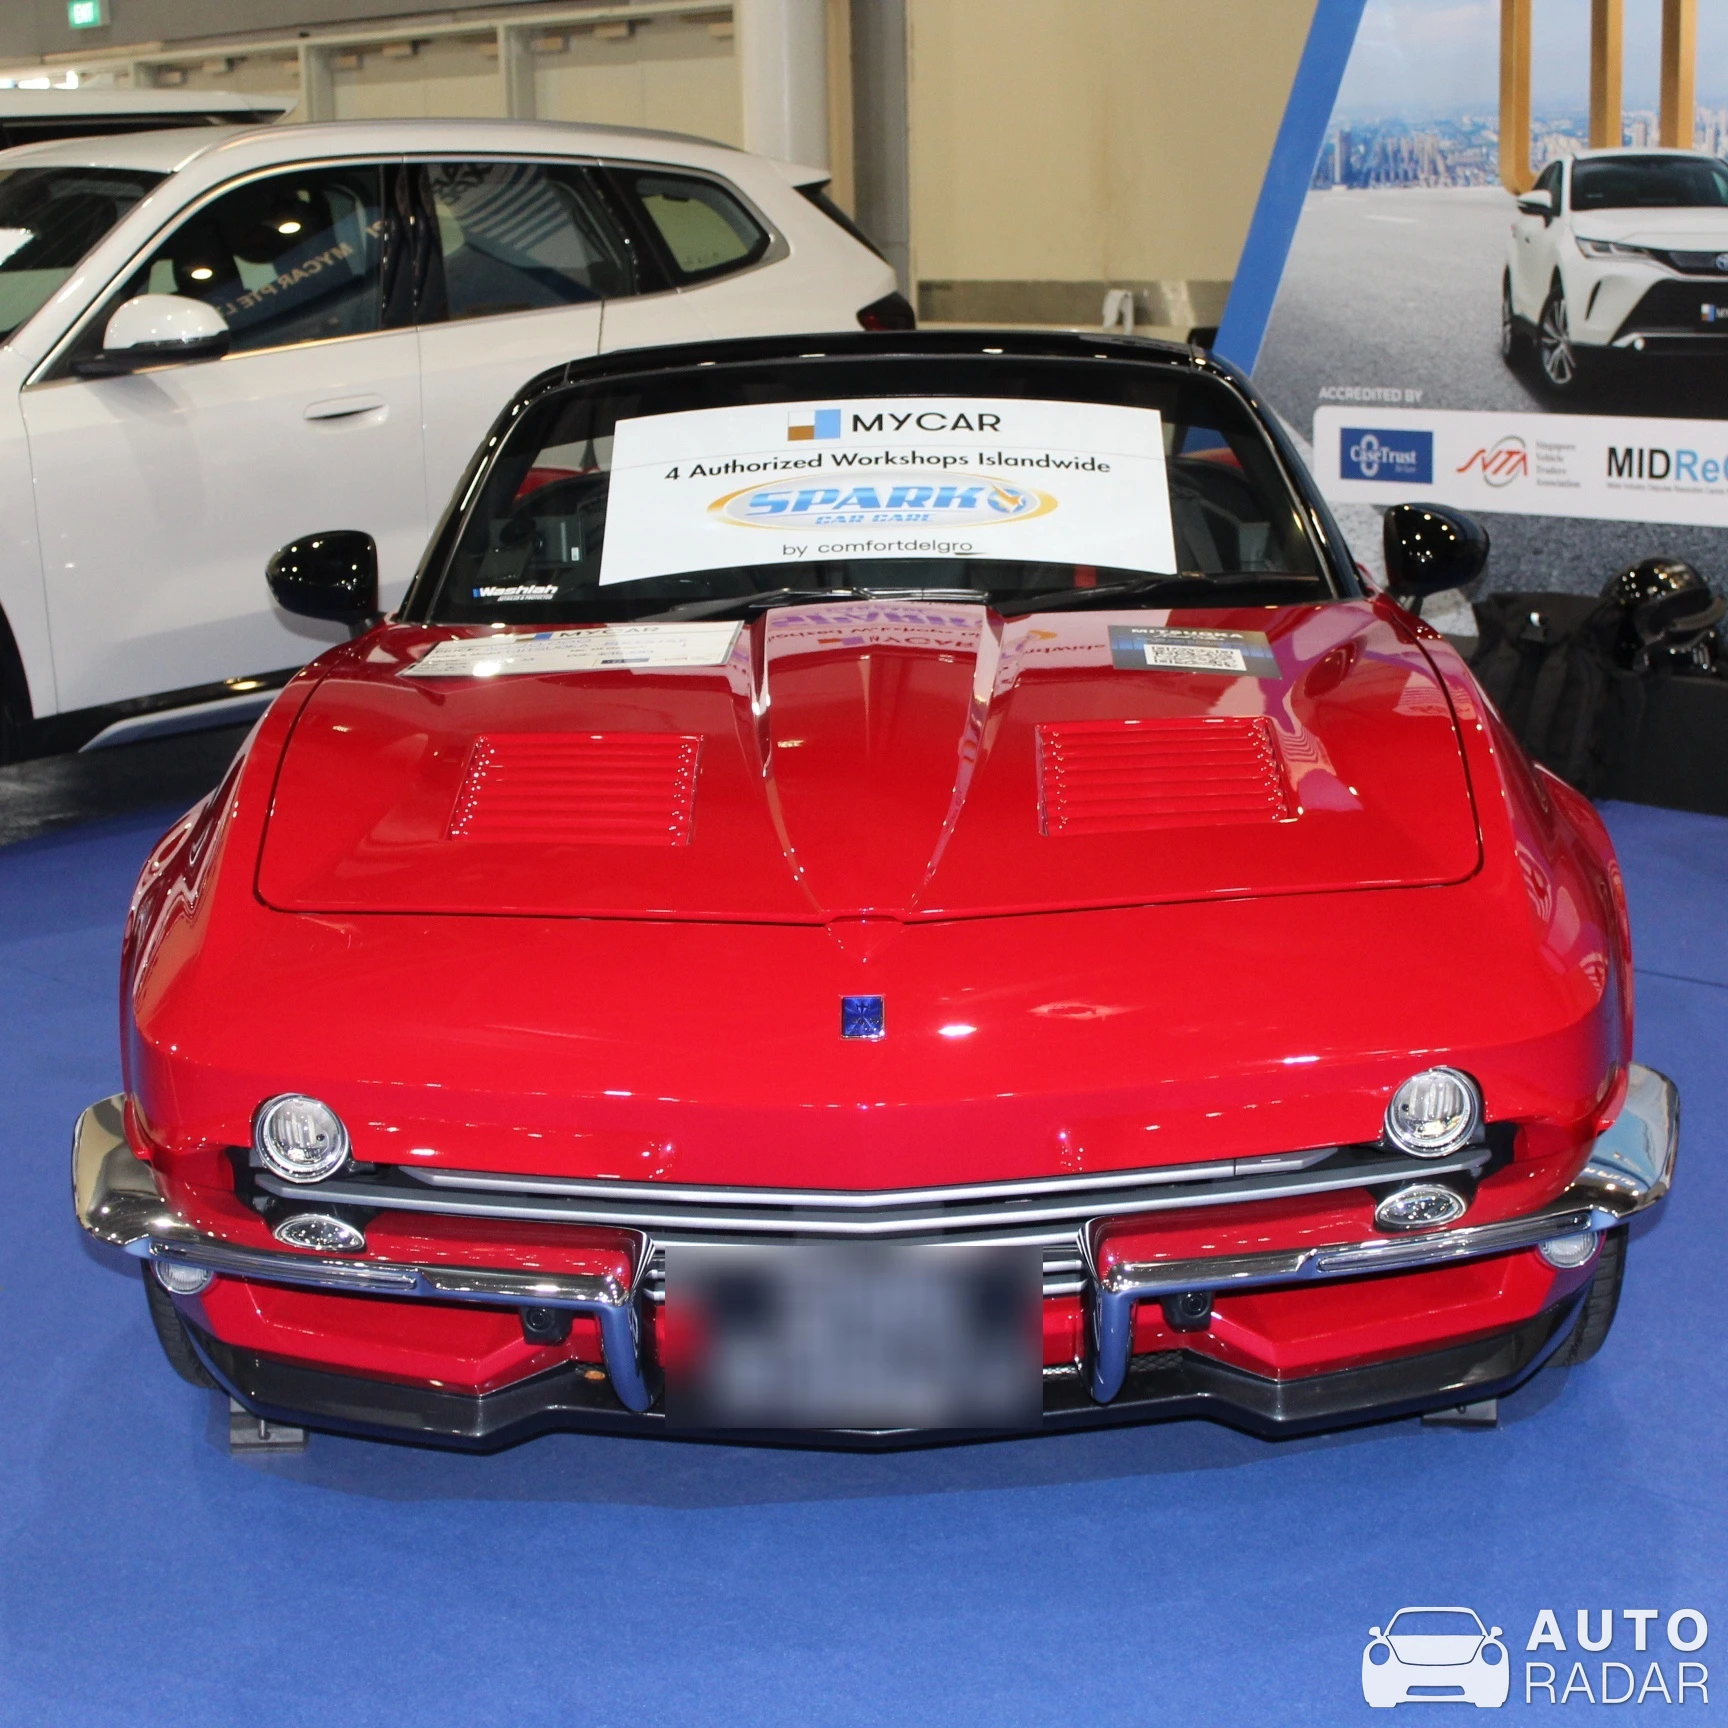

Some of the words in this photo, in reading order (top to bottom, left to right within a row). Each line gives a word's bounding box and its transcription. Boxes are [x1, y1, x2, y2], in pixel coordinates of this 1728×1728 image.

[1318, 386, 1401, 402] ACCREDITED
[1404, 389, 1424, 403] BY
[852, 413, 1002, 432] MYCAR
[1350, 445, 1417, 464] CaseTrust
[664, 467, 680, 480] 4
[689, 453, 823, 478] Authorized
[831, 450, 969, 468] Workshops
[978, 452, 1111, 473] Islandwide
[746, 486, 985, 514] SPARK
[814, 514, 865, 525] CAR
[872, 513, 937, 522] CARE
[782, 544, 808, 558] by
[818, 539, 973, 553] comfortdelgro
[559, 627, 660, 637] MYCAR
[1131, 628, 1245, 639] MITSUOKA
